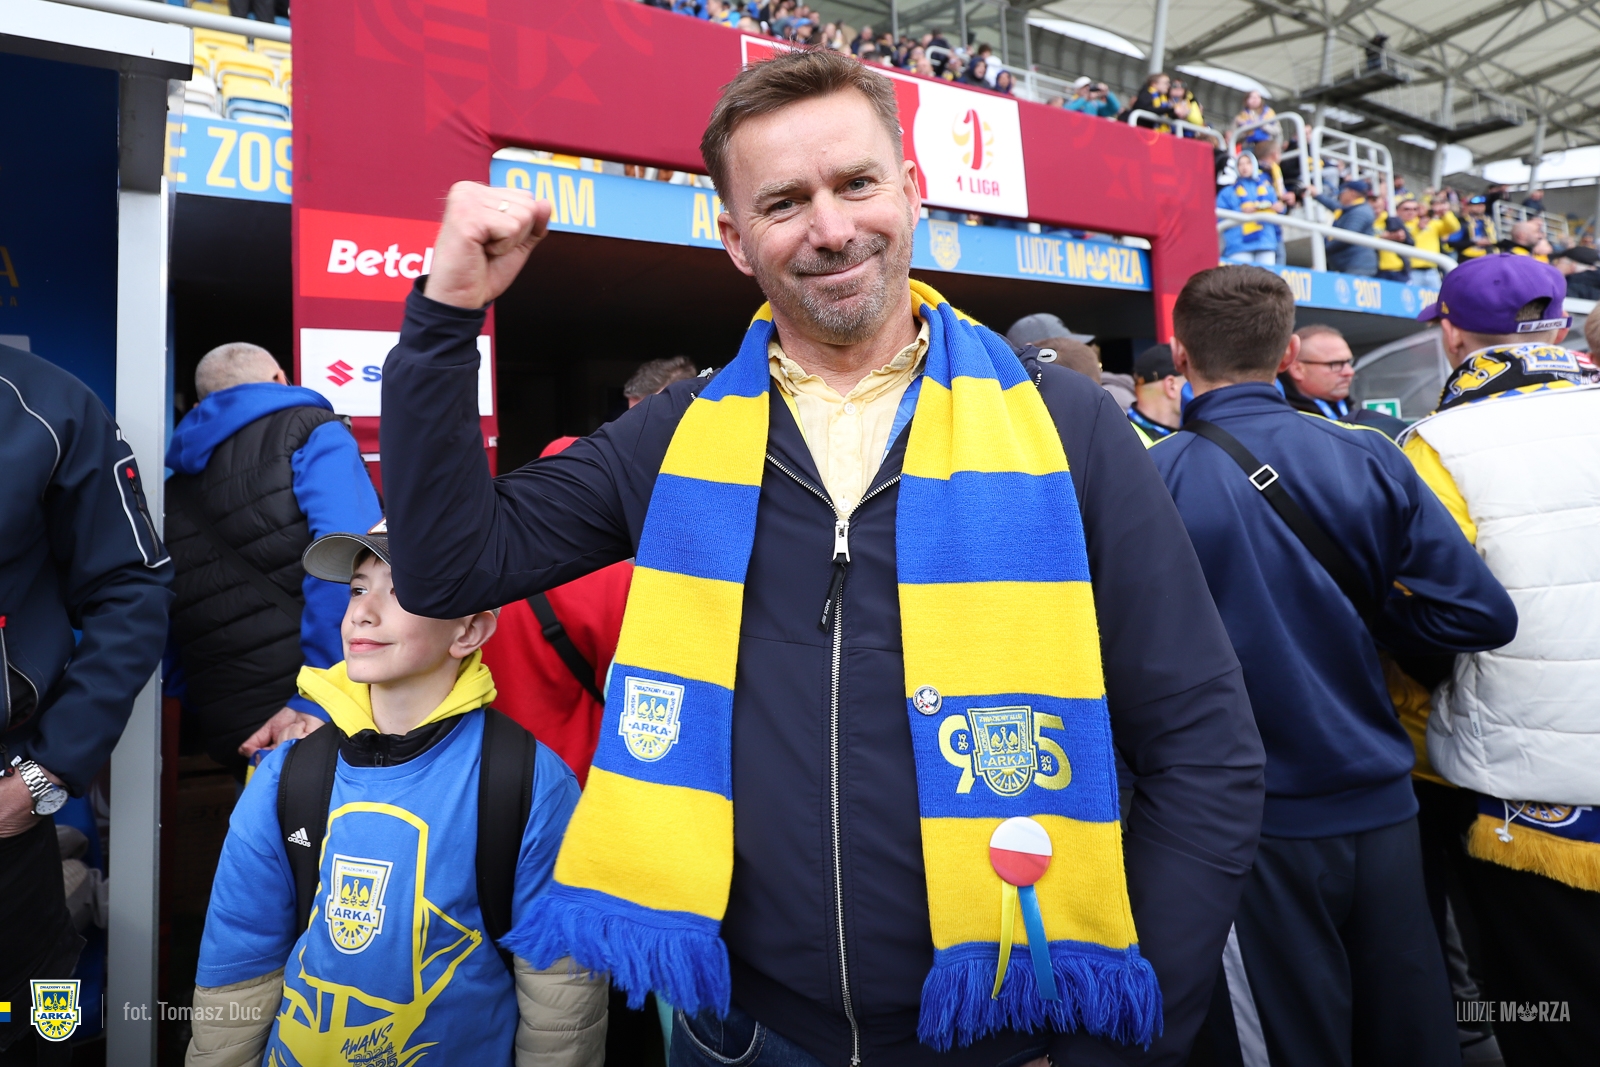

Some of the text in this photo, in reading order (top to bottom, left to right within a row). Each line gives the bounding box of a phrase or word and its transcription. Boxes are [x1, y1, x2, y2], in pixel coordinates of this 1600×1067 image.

[163, 122, 292, 195] E ZOS
[957, 175, 1000, 197] 1 LIGA
[327, 239, 434, 279] Betcl
[1016, 235, 1065, 277] LUDZIE
[1353, 279, 1381, 309] 2017
[631, 721, 669, 736] ARKA
[987, 754, 1027, 767] ARKA
[288, 836, 311, 847] adidas
[333, 907, 372, 923] ARKA
[340, 1022, 394, 1059] AWANS
